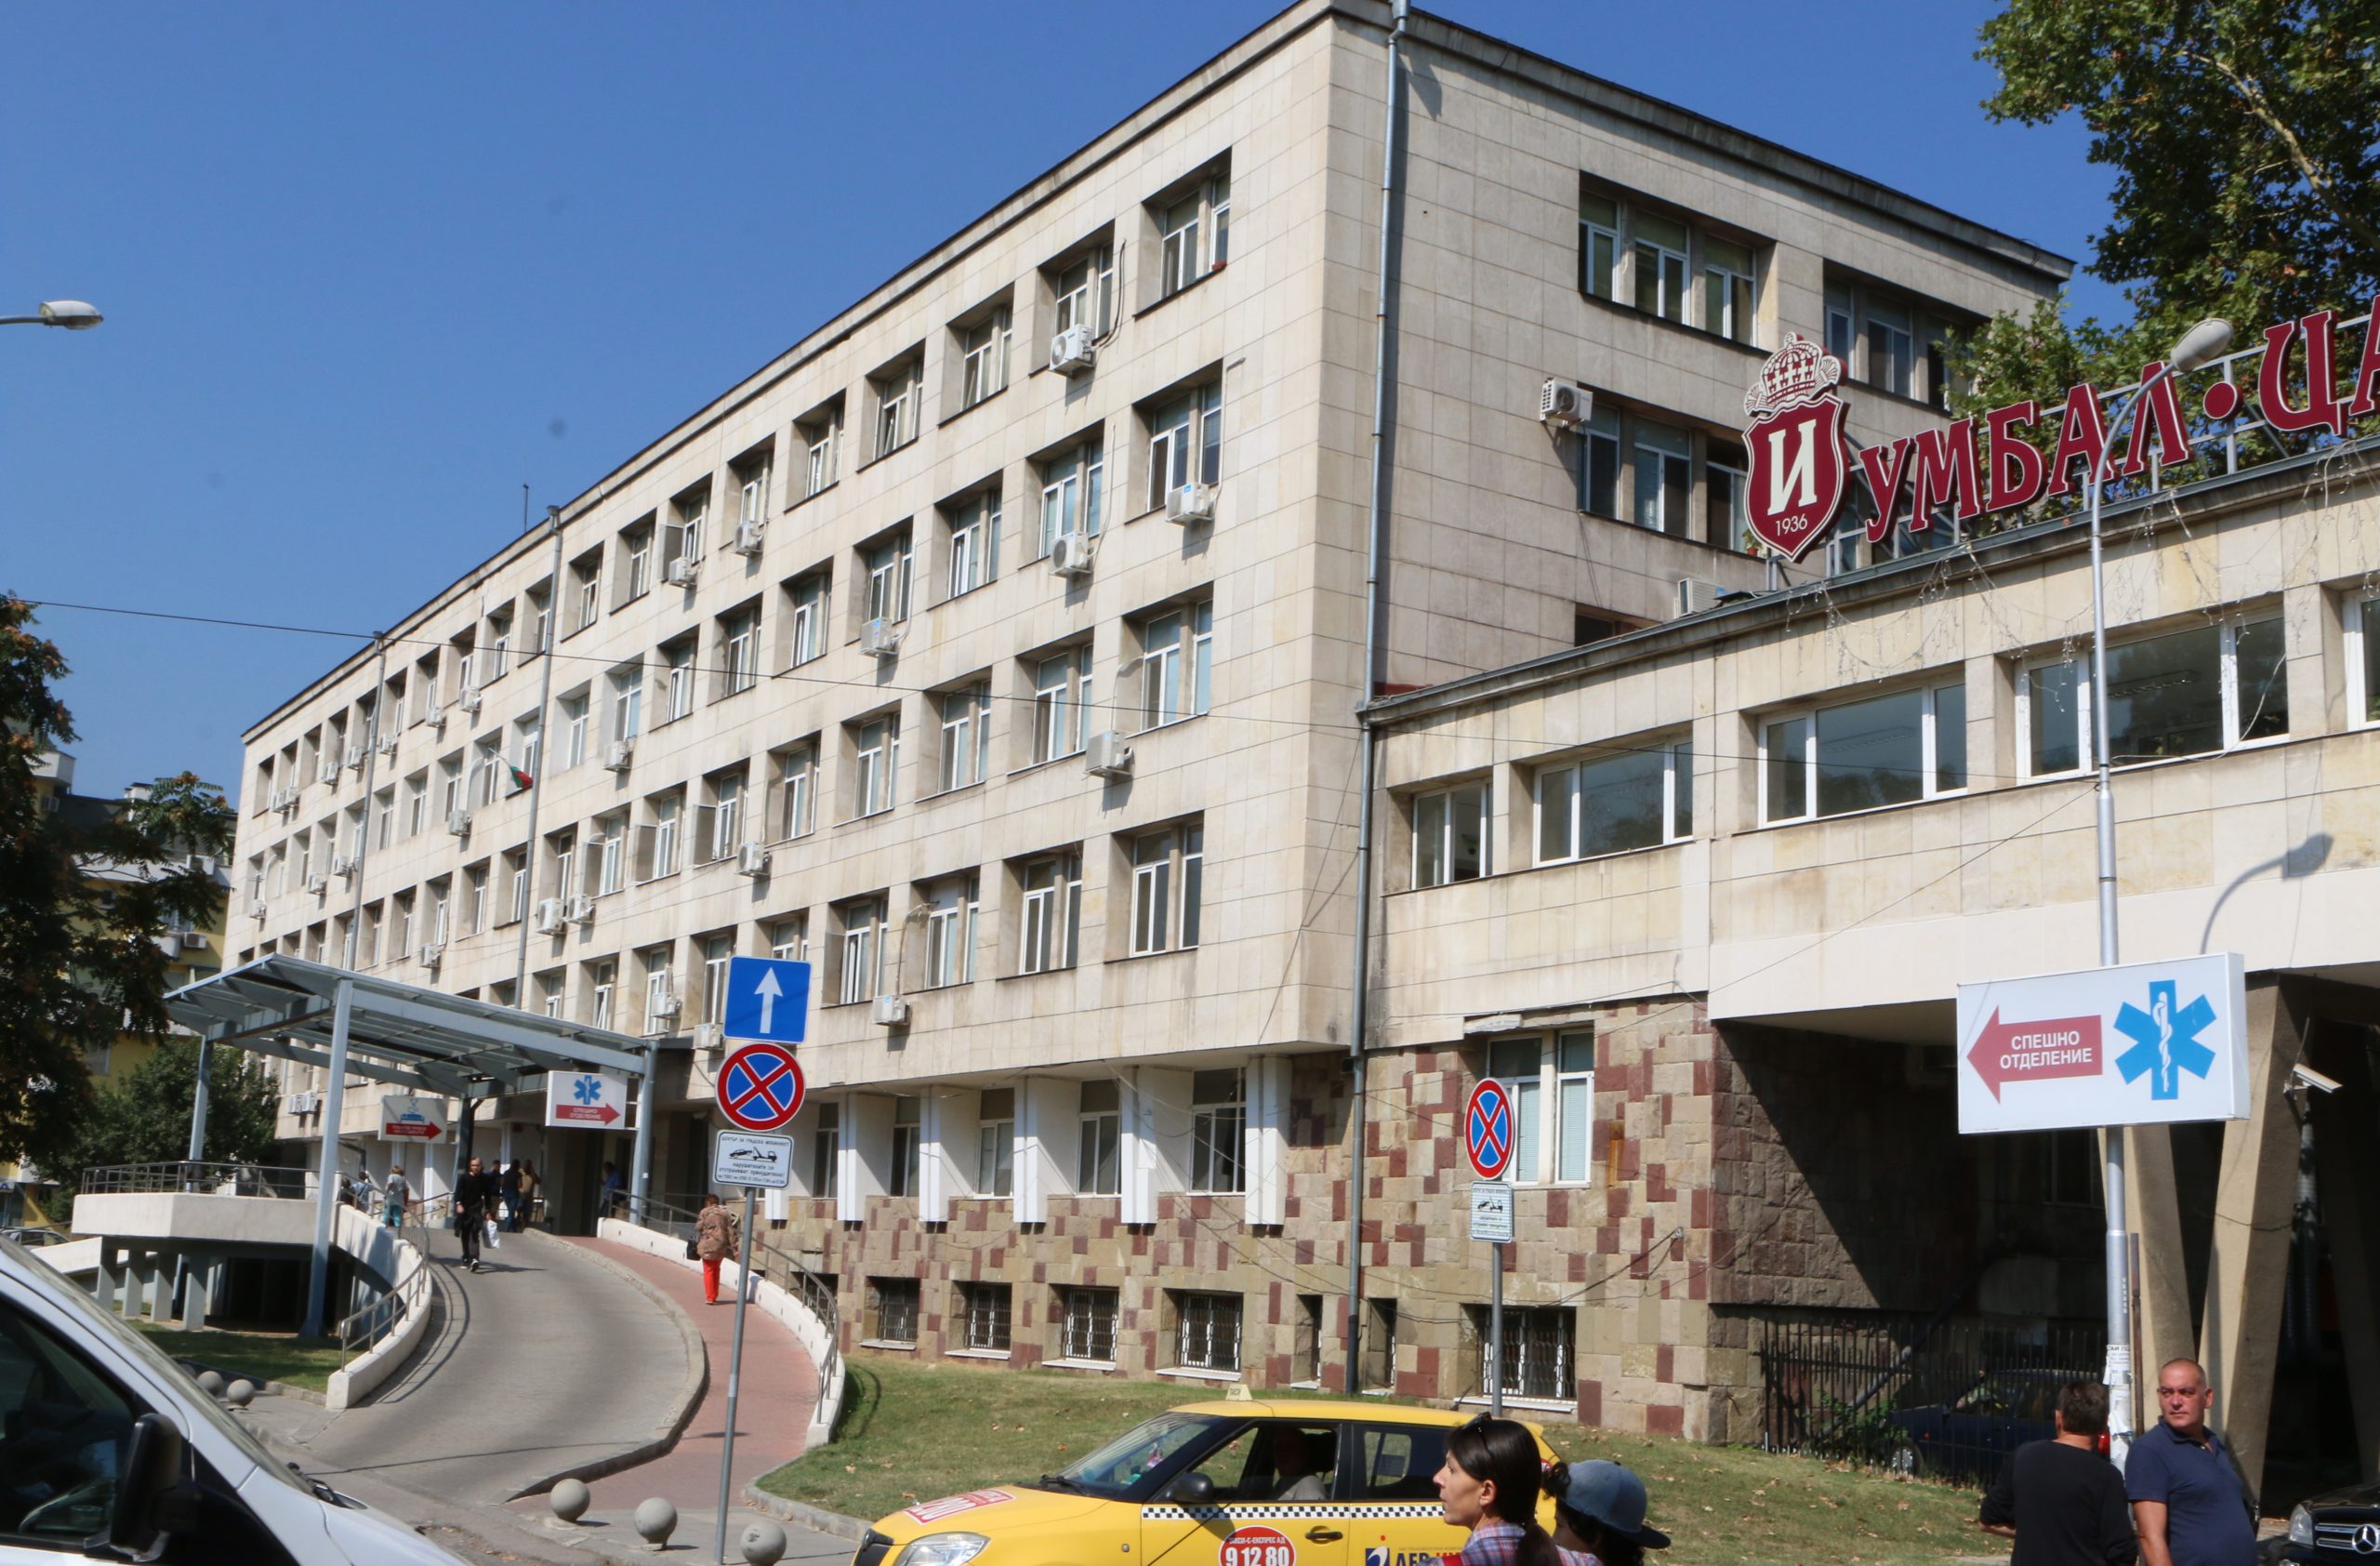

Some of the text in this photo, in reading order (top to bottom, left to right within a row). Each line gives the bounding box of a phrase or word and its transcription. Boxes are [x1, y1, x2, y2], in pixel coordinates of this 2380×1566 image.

[1859, 361, 2196, 543] УМБАЛ
[1767, 418, 1819, 517] И
[1776, 512, 1808, 537] 1936
[2011, 1030, 2080, 1050] СПЕШНО
[2000, 1047, 2092, 1070] ОТДЕЛЕНИЕ
